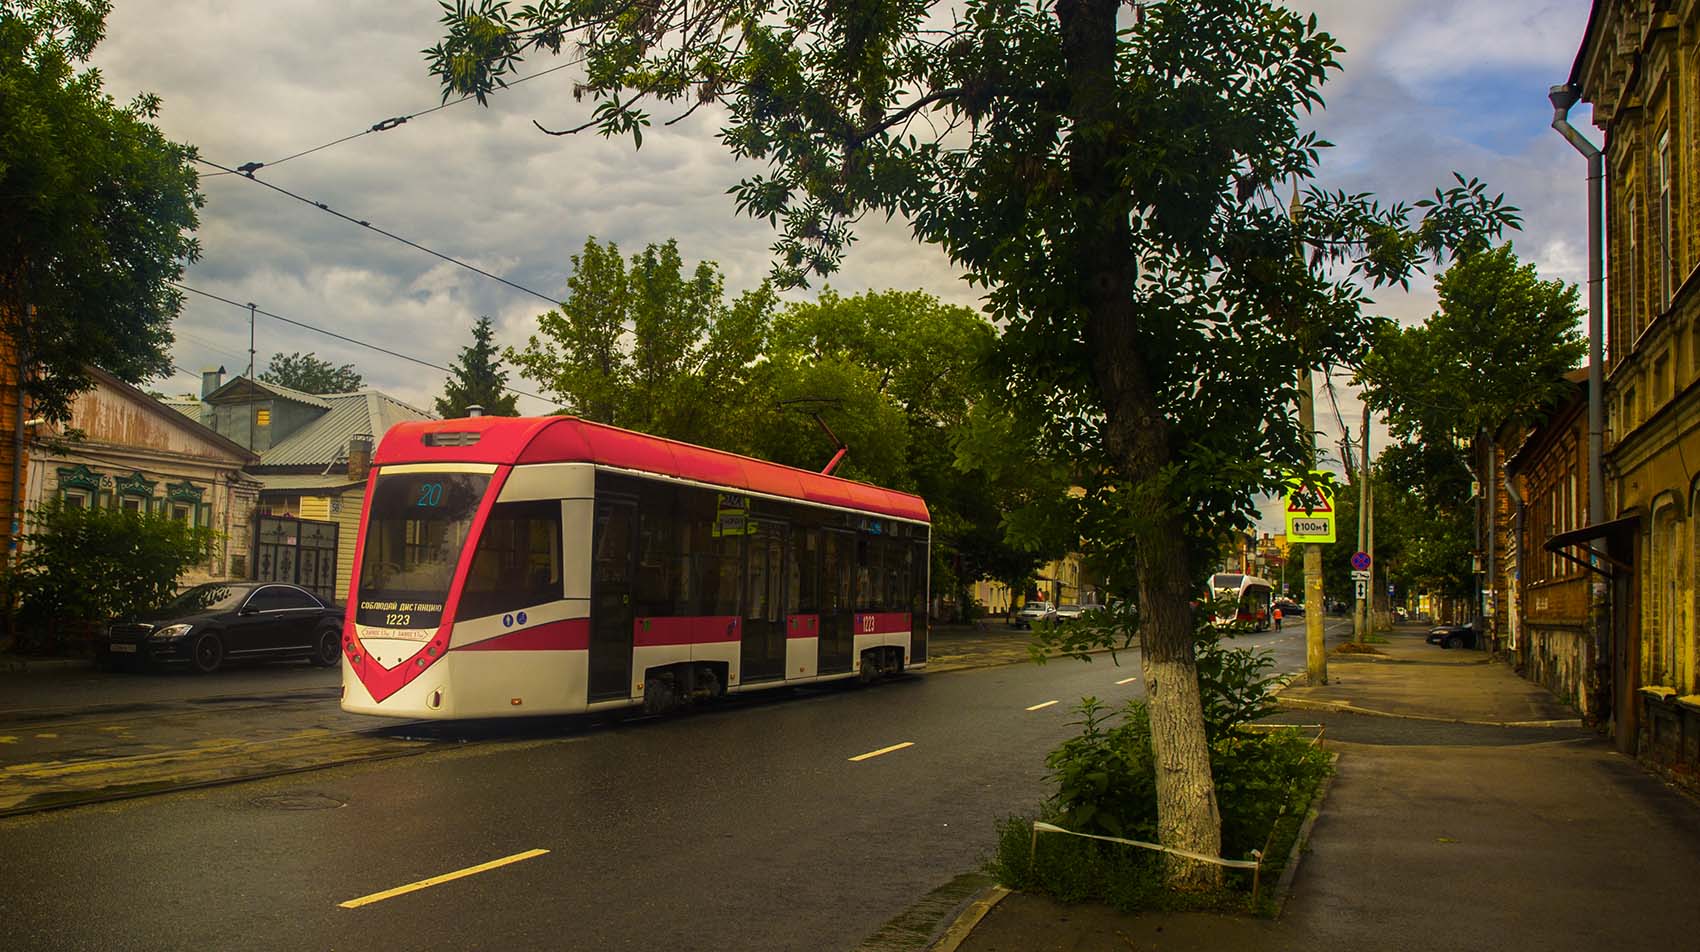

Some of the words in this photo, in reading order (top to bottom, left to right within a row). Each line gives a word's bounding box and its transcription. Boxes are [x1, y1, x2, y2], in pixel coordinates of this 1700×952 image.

[417, 483, 442, 506] 20
[360, 601, 398, 611] СОБЛЮДАЙ
[399, 602, 442, 612] ДИСТАНЦИЮ
[386, 613, 411, 626] 1223
[863, 615, 875, 632] 1223
